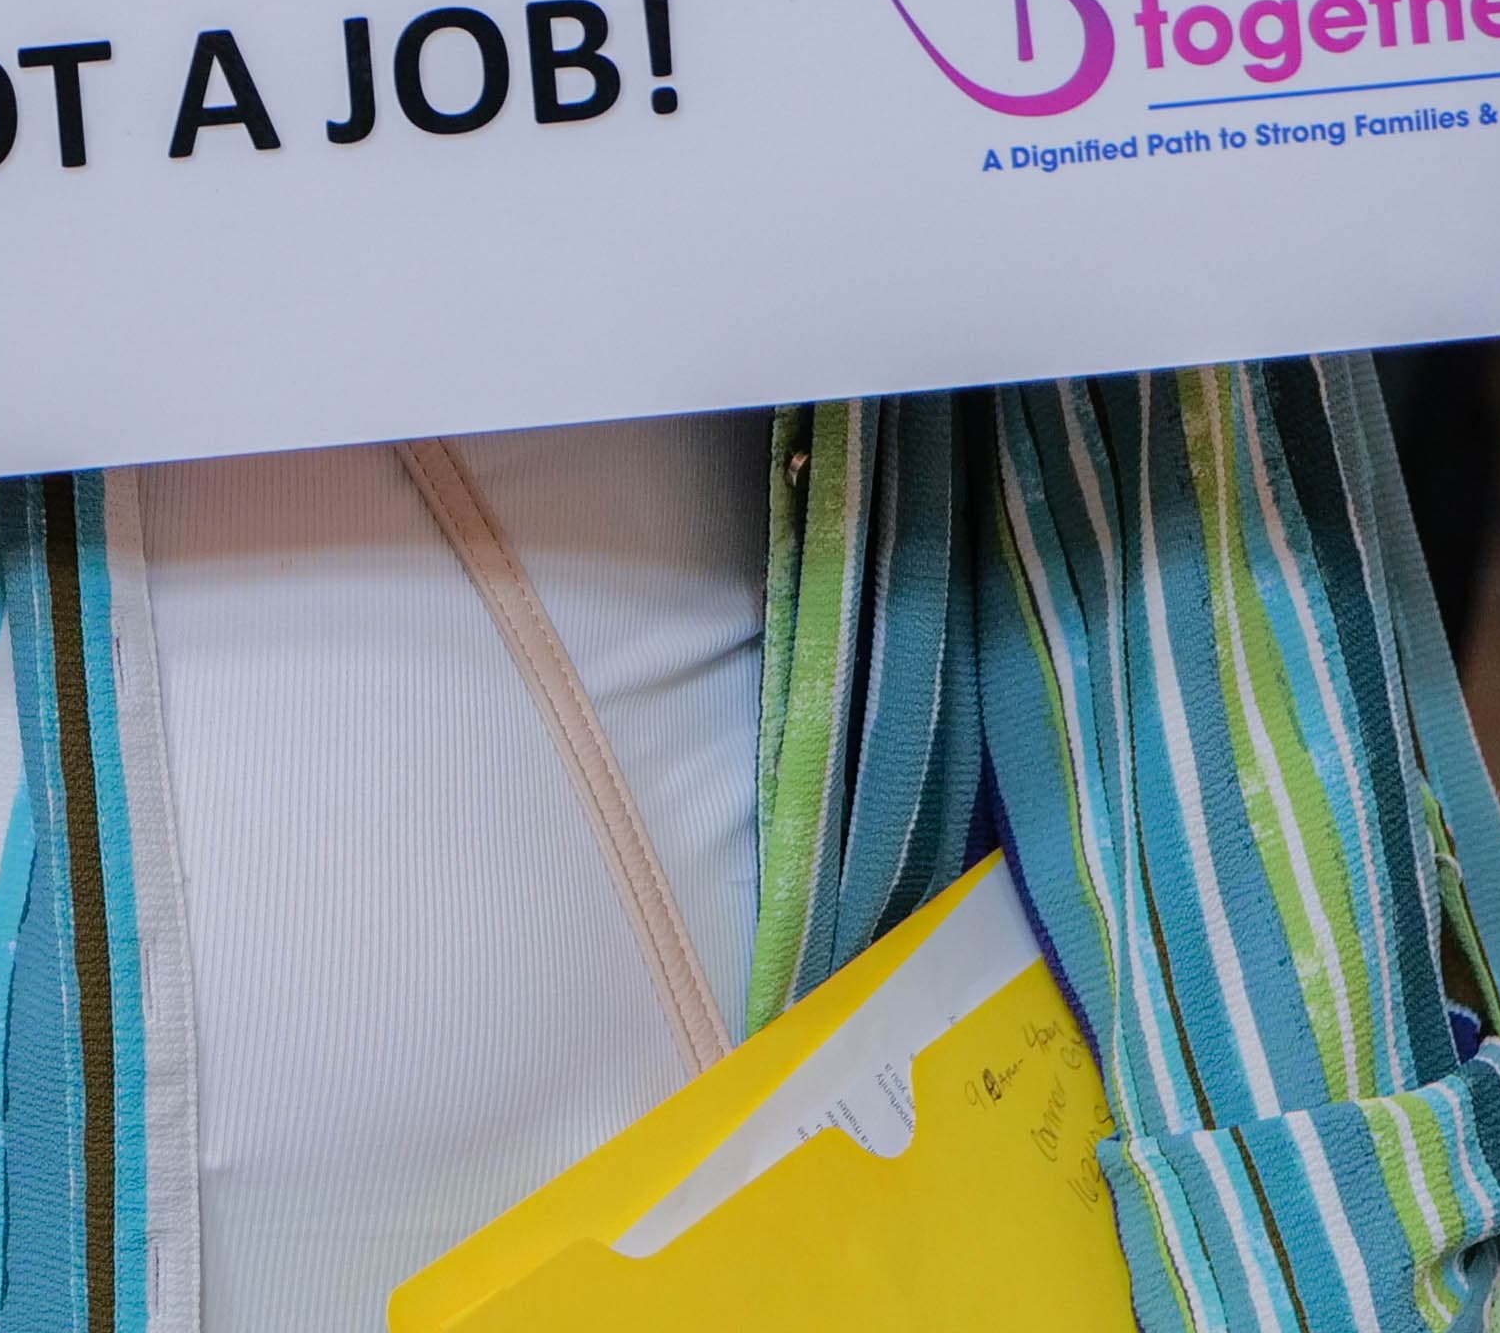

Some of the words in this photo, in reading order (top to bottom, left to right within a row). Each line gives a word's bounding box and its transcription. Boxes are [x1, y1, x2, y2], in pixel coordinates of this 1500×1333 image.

[168, 29, 281, 159] A
[981, 148, 1003, 173] A
[1011, 135, 1138, 173] Dignified
[1147, 130, 1211, 158] Path
[1219, 125, 1247, 151] to
[1255, 118, 1346, 147] Strong
[1354, 104, 1470, 137] Families
[1478, 102, 1499, 126] &
